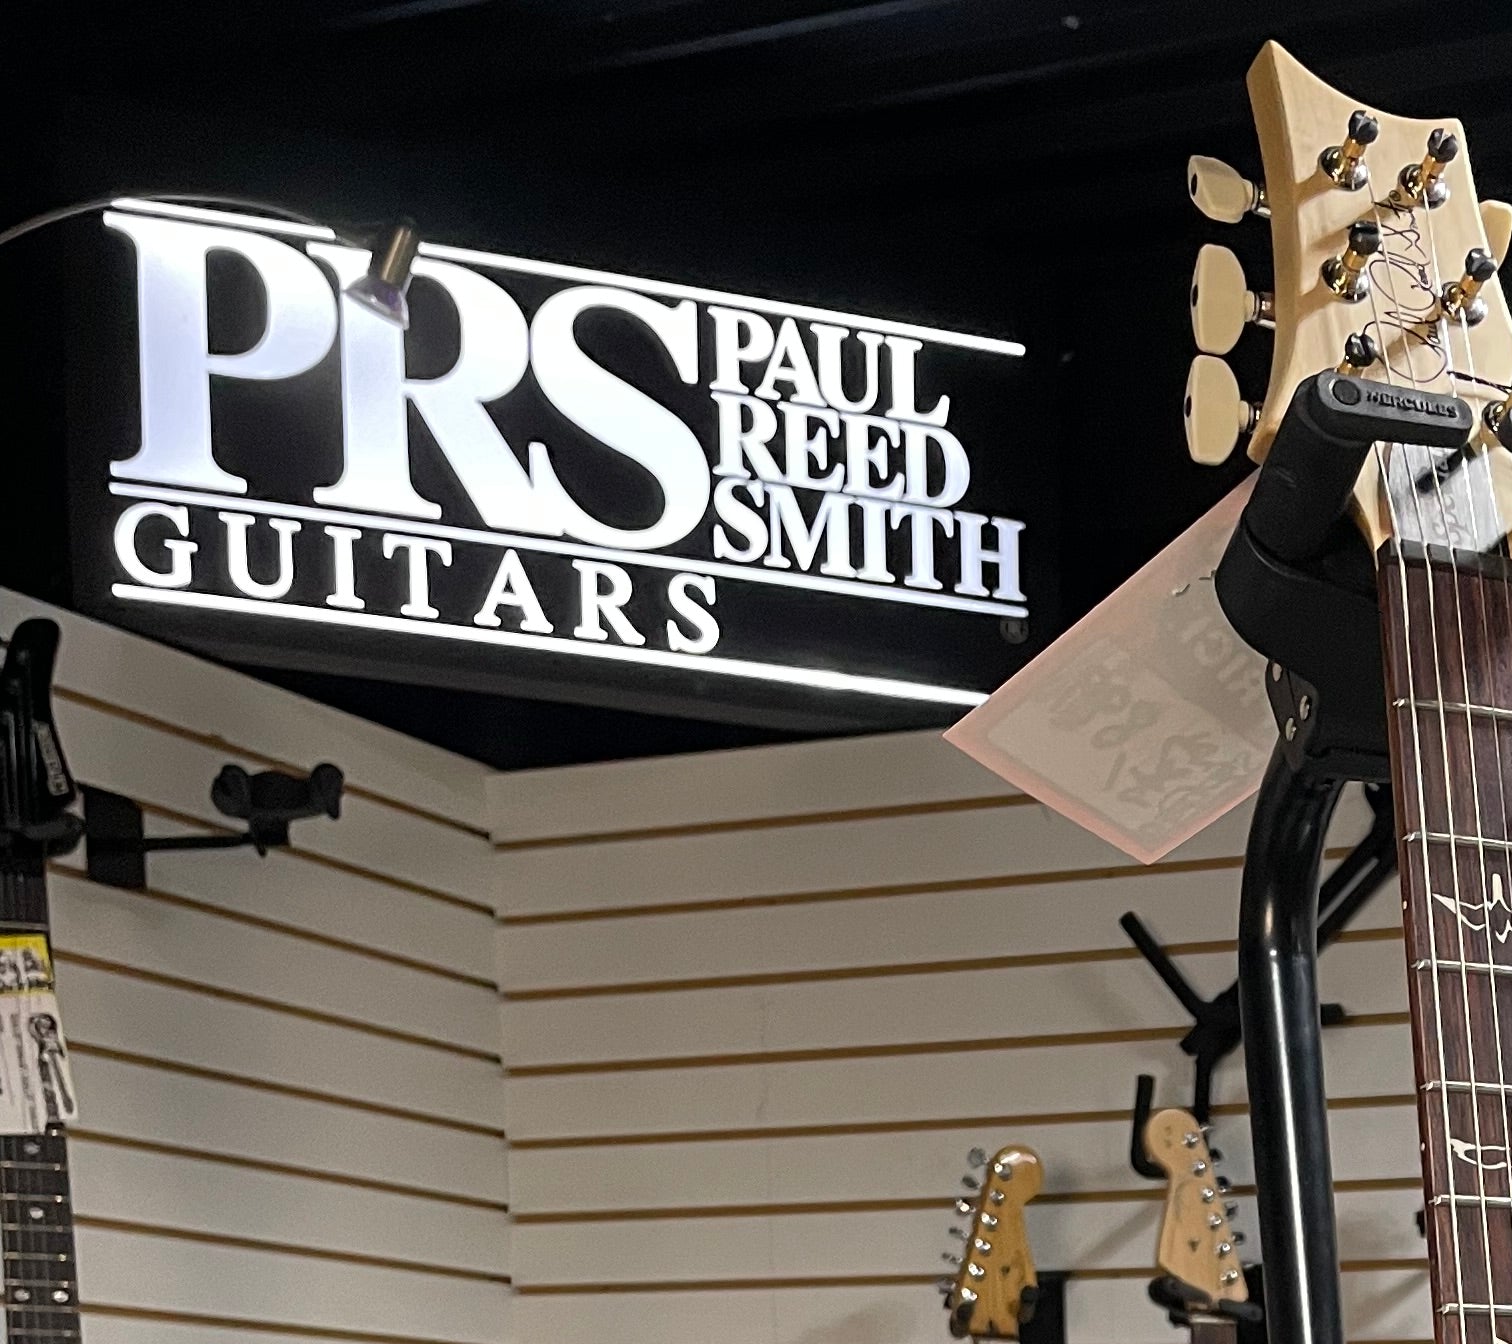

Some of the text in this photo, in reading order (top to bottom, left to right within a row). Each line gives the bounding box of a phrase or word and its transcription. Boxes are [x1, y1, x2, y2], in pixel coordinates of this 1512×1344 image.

[103, 212, 712, 550] PRS
[709, 304, 950, 426] PAUL
[1366, 389, 1458, 418] HERCULES
[711, 391, 972, 508] REED
[112, 500, 721, 655] GUITARS
[712, 476, 1028, 602] SMITH
